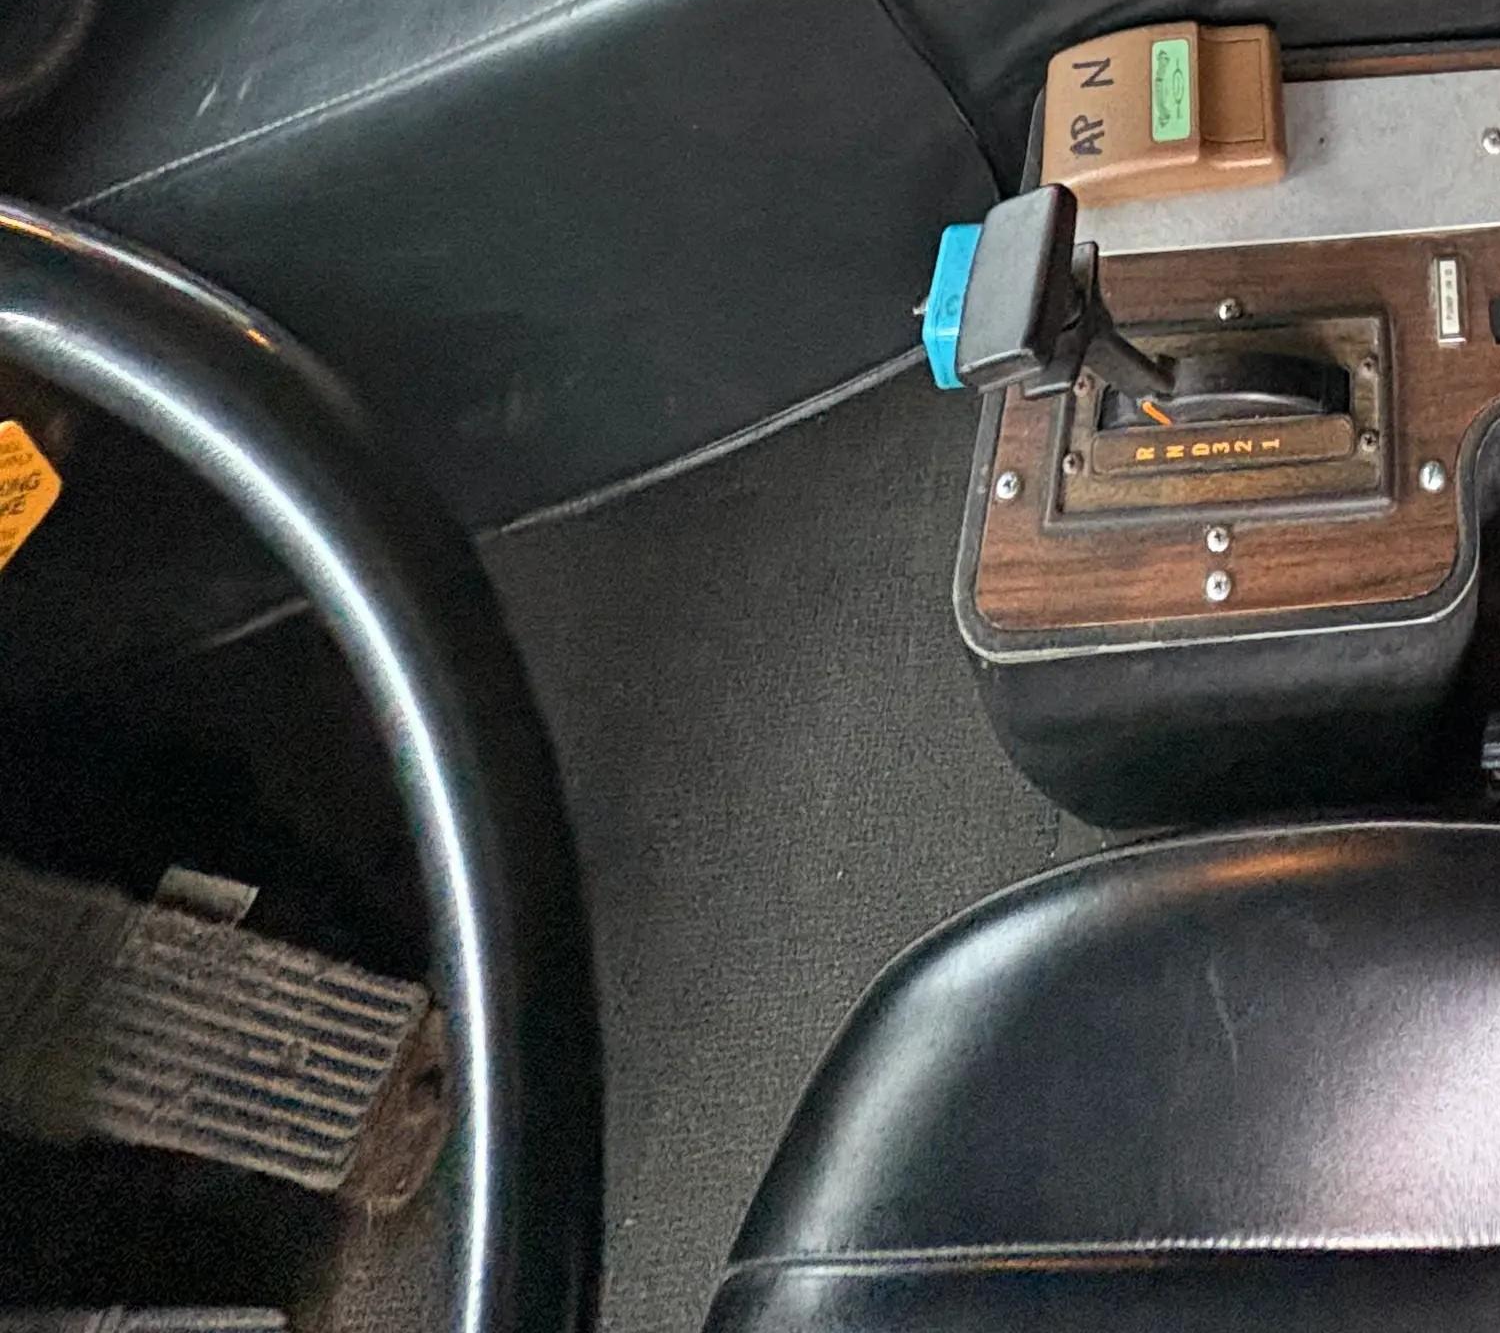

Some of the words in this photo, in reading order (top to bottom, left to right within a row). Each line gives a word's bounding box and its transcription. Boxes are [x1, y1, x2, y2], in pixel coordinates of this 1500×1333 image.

[1135, 446, 1155, 461] R
[1166, 445, 1185, 459] N
[1191, 442, 1210, 457] D
[1212, 441, 1230, 454] 3
[1234, 439, 1253, 454] 2
[1262, 438, 1281, 450] 1
